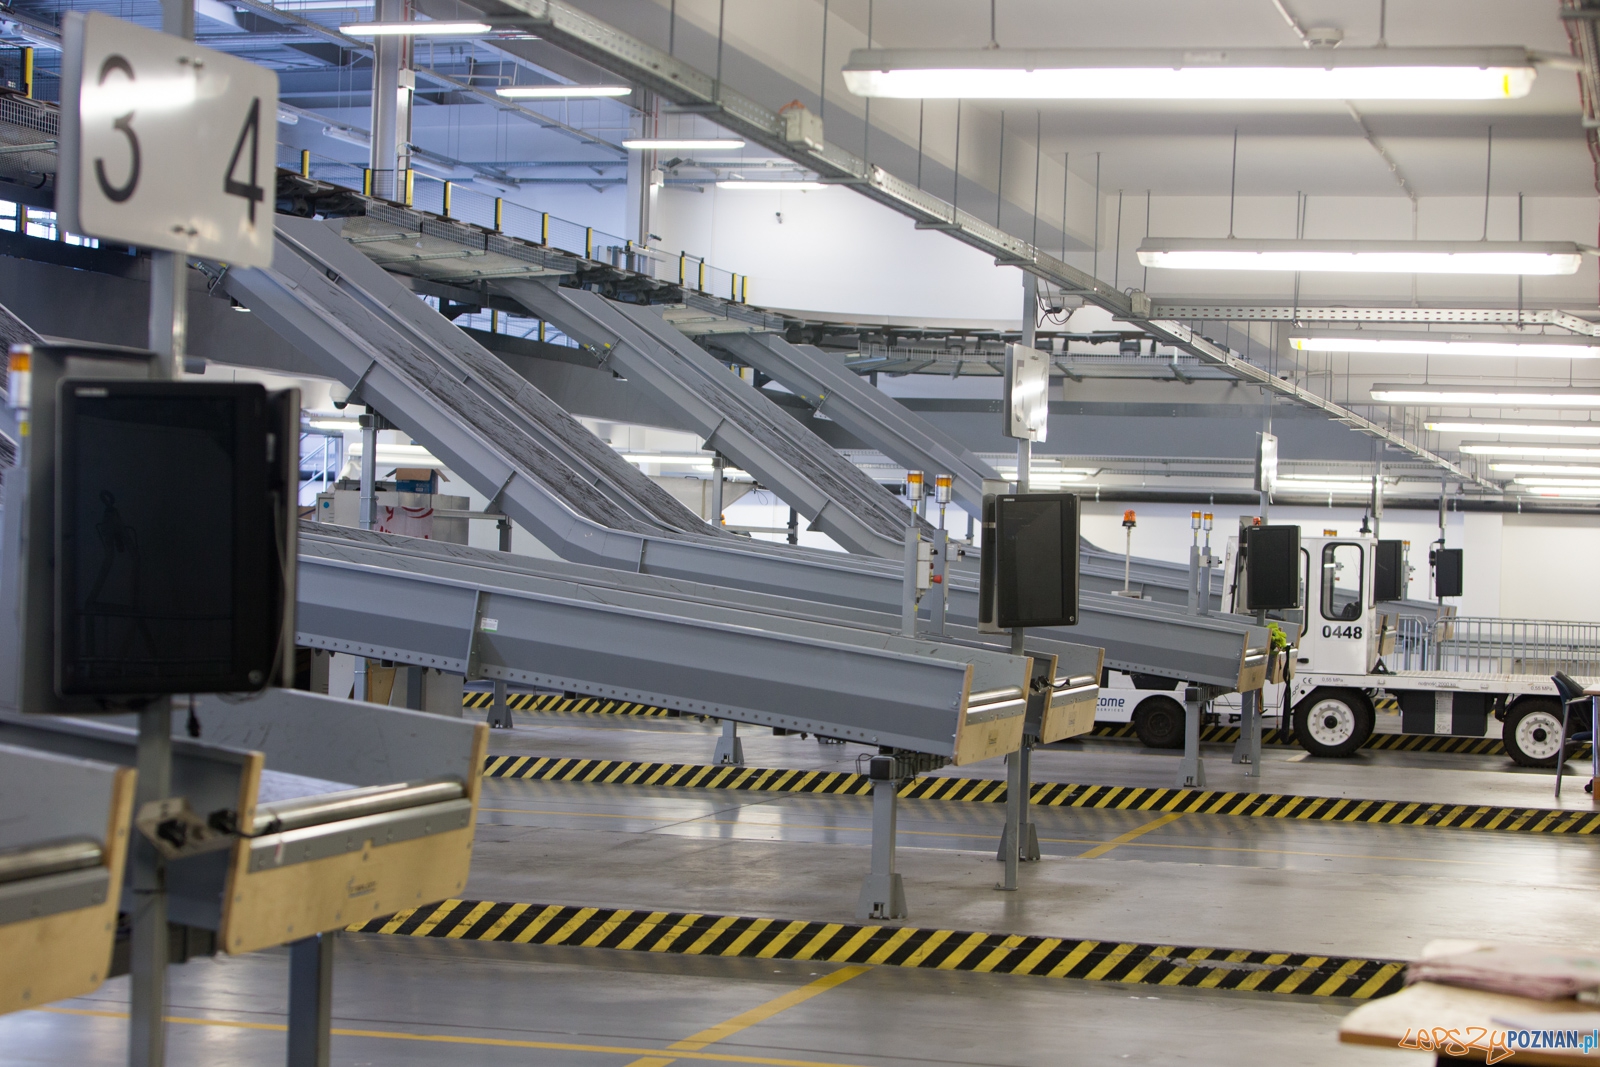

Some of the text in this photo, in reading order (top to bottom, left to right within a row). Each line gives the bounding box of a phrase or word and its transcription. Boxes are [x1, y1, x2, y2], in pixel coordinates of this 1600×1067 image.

[94, 54, 264, 227] 3 4
[1322, 625, 1362, 639] 0448
